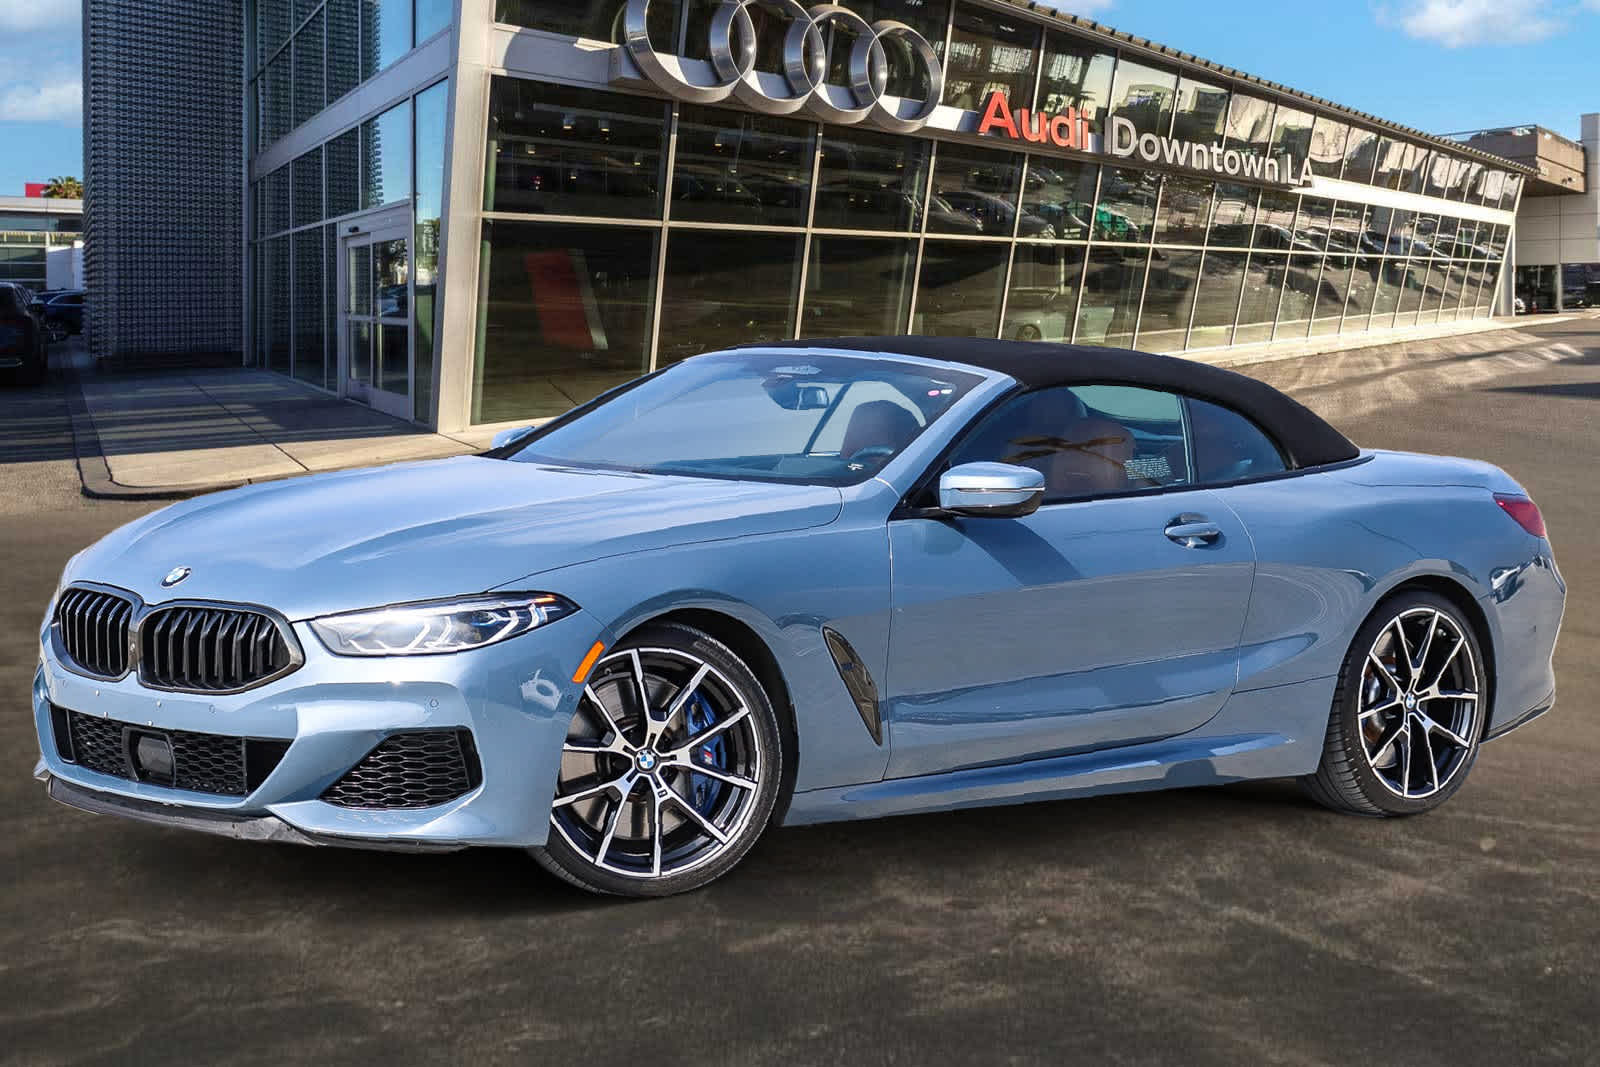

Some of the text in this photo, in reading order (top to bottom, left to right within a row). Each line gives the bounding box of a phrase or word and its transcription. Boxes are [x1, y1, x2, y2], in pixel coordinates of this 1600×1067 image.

[978, 91, 1315, 187] Audi Downtown LA
